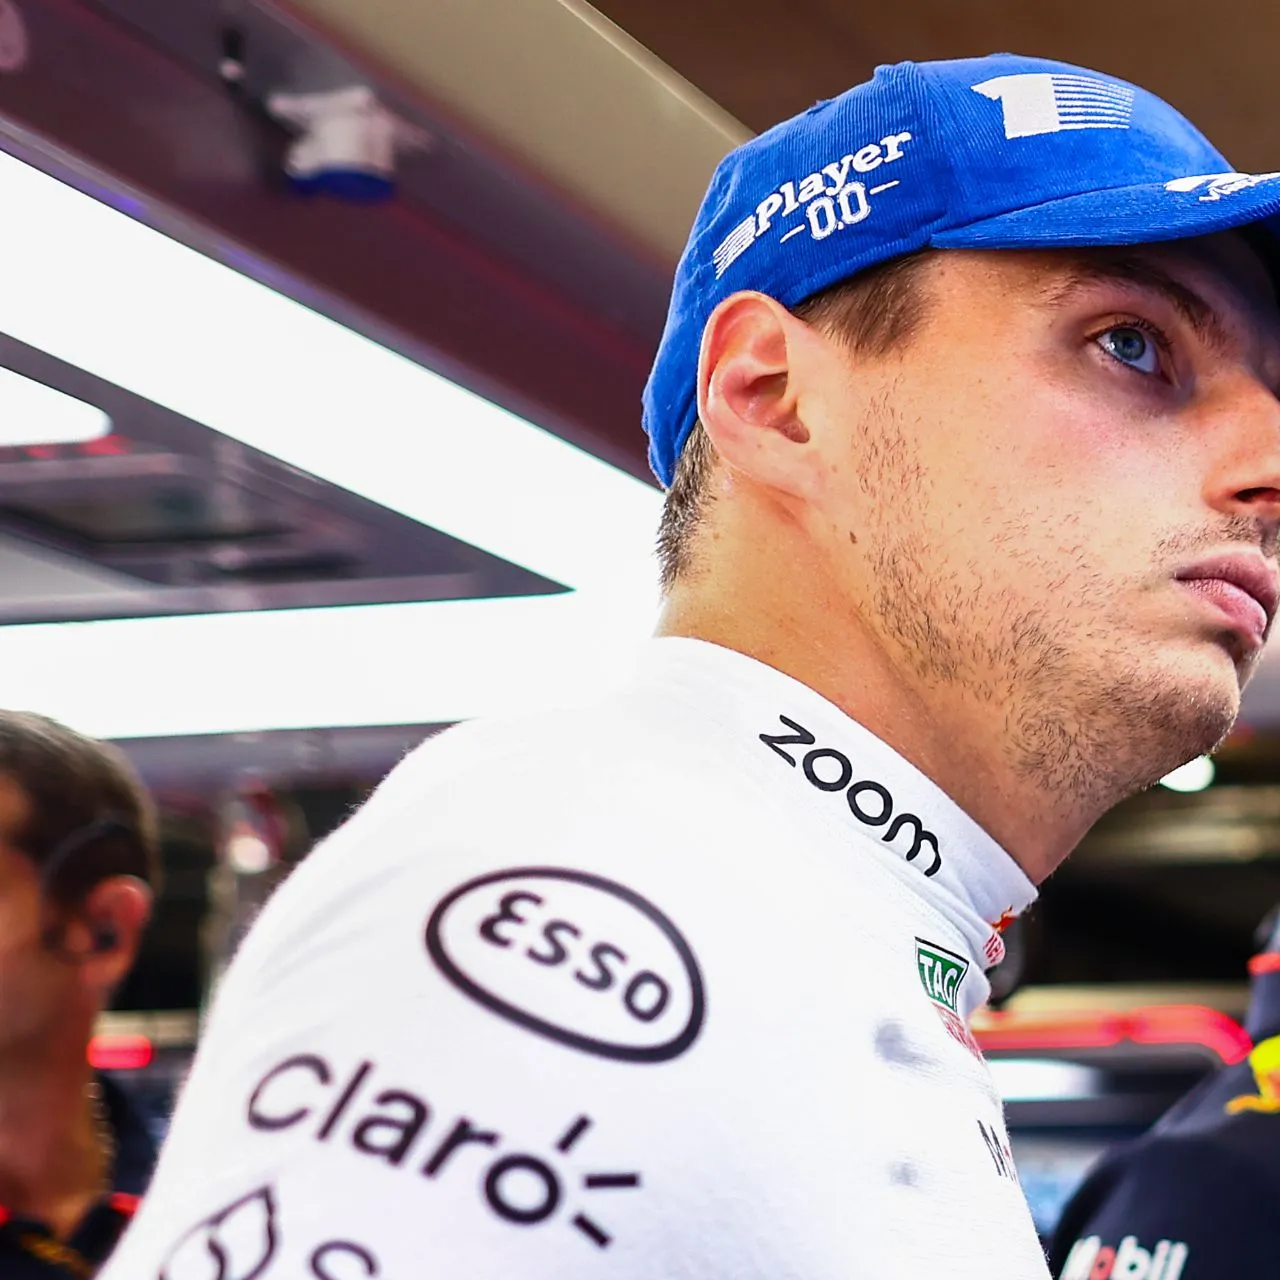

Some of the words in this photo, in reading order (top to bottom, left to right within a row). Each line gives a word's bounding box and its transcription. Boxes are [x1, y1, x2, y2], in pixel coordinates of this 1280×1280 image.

[754, 131, 912, 237] Player
[758, 713, 943, 877] zoom
[919, 954, 958, 1007] TAG
